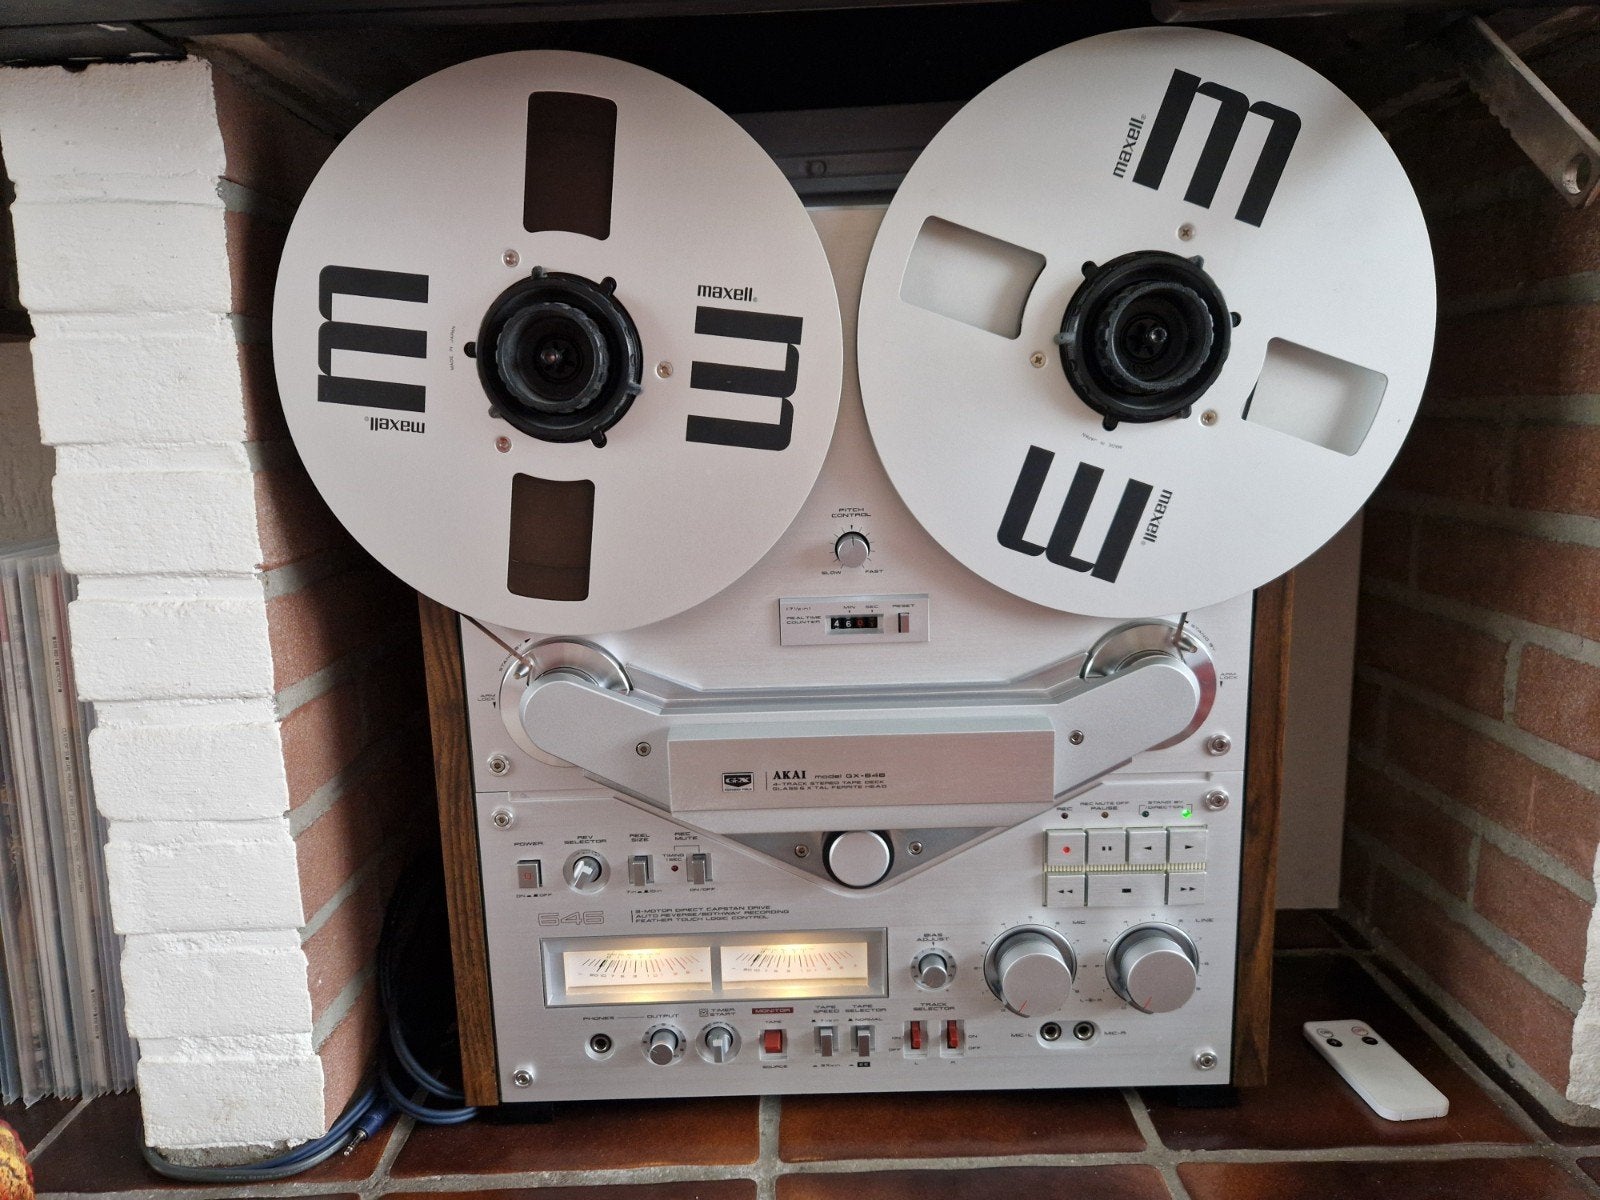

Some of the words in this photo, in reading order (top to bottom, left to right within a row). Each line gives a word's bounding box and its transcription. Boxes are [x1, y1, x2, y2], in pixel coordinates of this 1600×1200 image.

[1113, 117, 1144, 178] maxell
[697, 284, 753, 302] maxell
[369, 417, 425, 433] maxell
[1143, 489, 1173, 543] maxell
[773, 770, 806, 780] AKAI
